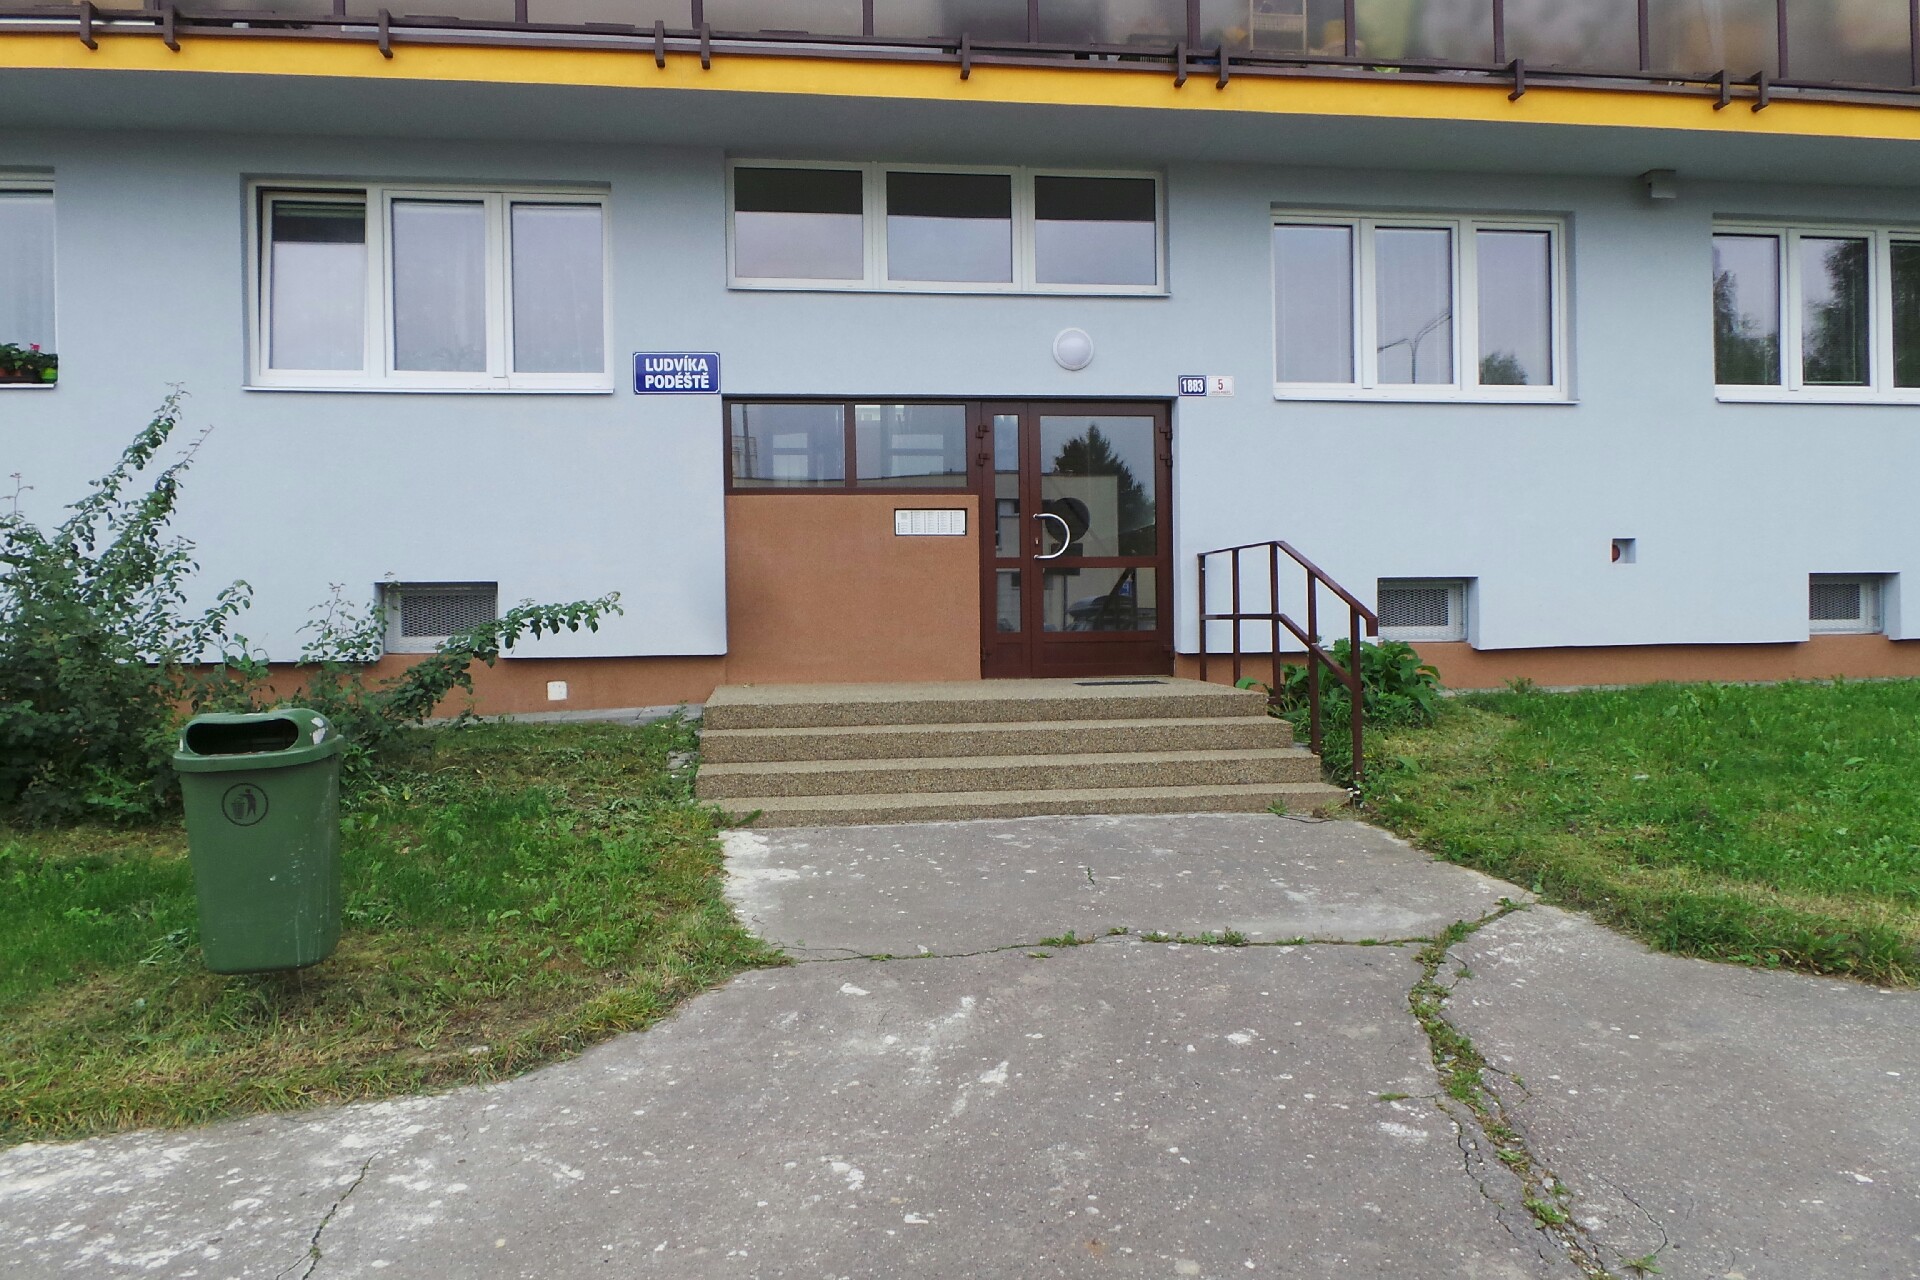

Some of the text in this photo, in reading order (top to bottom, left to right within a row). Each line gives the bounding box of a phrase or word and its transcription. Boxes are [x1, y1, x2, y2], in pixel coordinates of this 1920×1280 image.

[645, 355, 708, 371] LUDVÍKA
[645, 372, 709, 388] PODÉŠTĚ
[1182, 379, 1204, 393] 1883
[1217, 378, 1224, 391] 5
